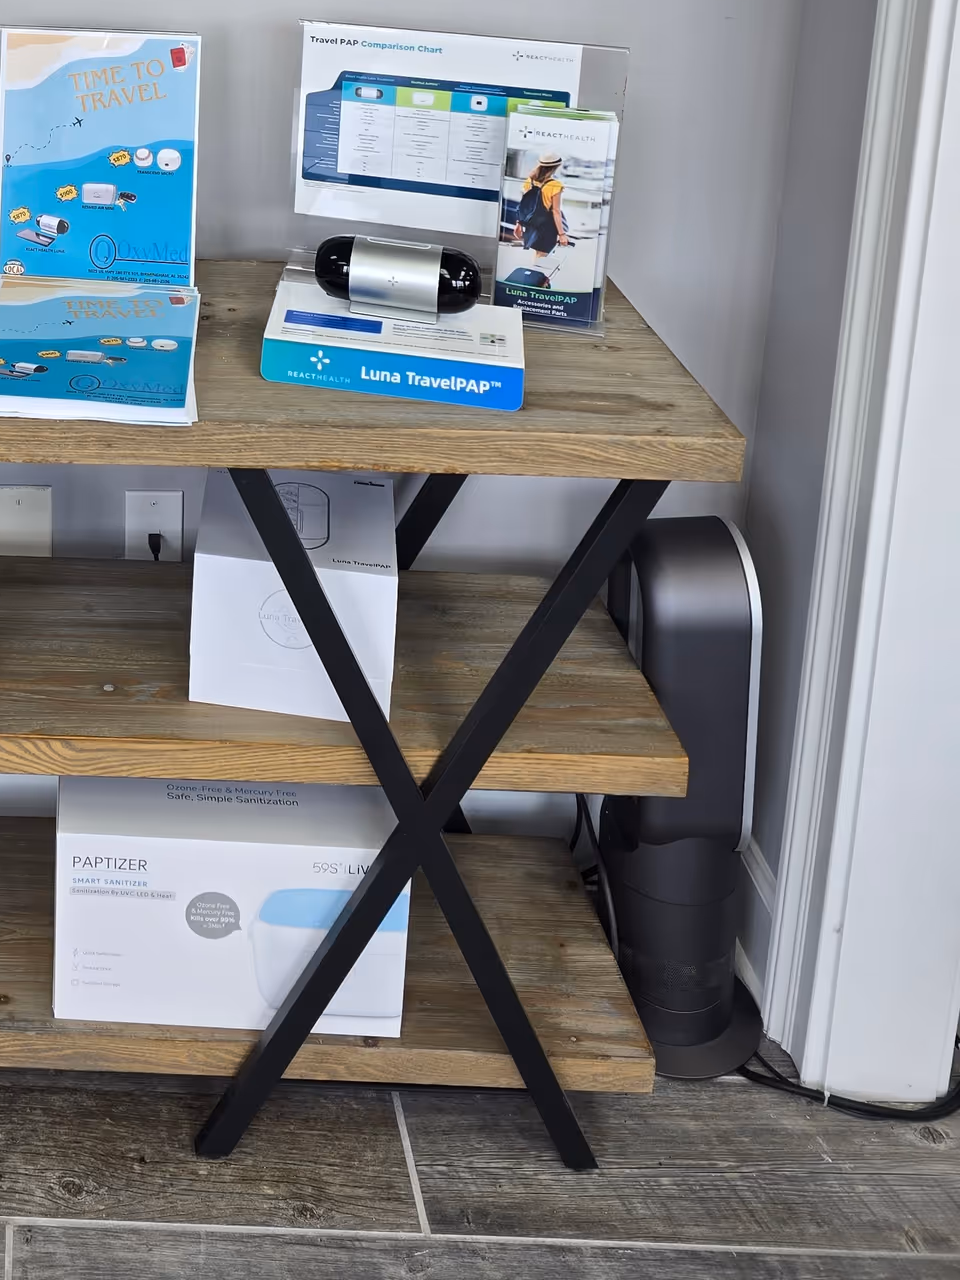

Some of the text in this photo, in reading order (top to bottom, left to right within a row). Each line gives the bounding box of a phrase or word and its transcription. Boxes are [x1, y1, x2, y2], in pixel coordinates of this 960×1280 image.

[310, 35, 443, 55] Travel PAP Comparison Chart
[67, 58, 166, 92] TIME TO
[75, 81, 168, 113] TRAVEL
[535, 130, 596, 142] REACTHEALTH
[505, 287, 578, 304] Luna TravelPAP
[61, 298, 164, 310] TIME TO
[513, 303, 551, 315] Replacement
[517, 299, 552, 309] Accessories
[66, 309, 166, 319] TRAVEL
[287, 370, 351, 384] REACTHEALTH
[360, 365, 401, 383] Luna
[353, 560, 391, 569] TravelPAP
[258, 611, 280, 621] Luna
[234, 787, 274, 797] Mercury
[275, 789, 297, 797] Free
[166, 792, 299, 807] Safe, Simple Sanitization
[72, 855, 148, 872] PAPTIZER
[72, 877, 148, 888] SMART SANITIZER
[71, 888, 110, 896] Sanitization
[196, 901, 216, 909] Ozone
